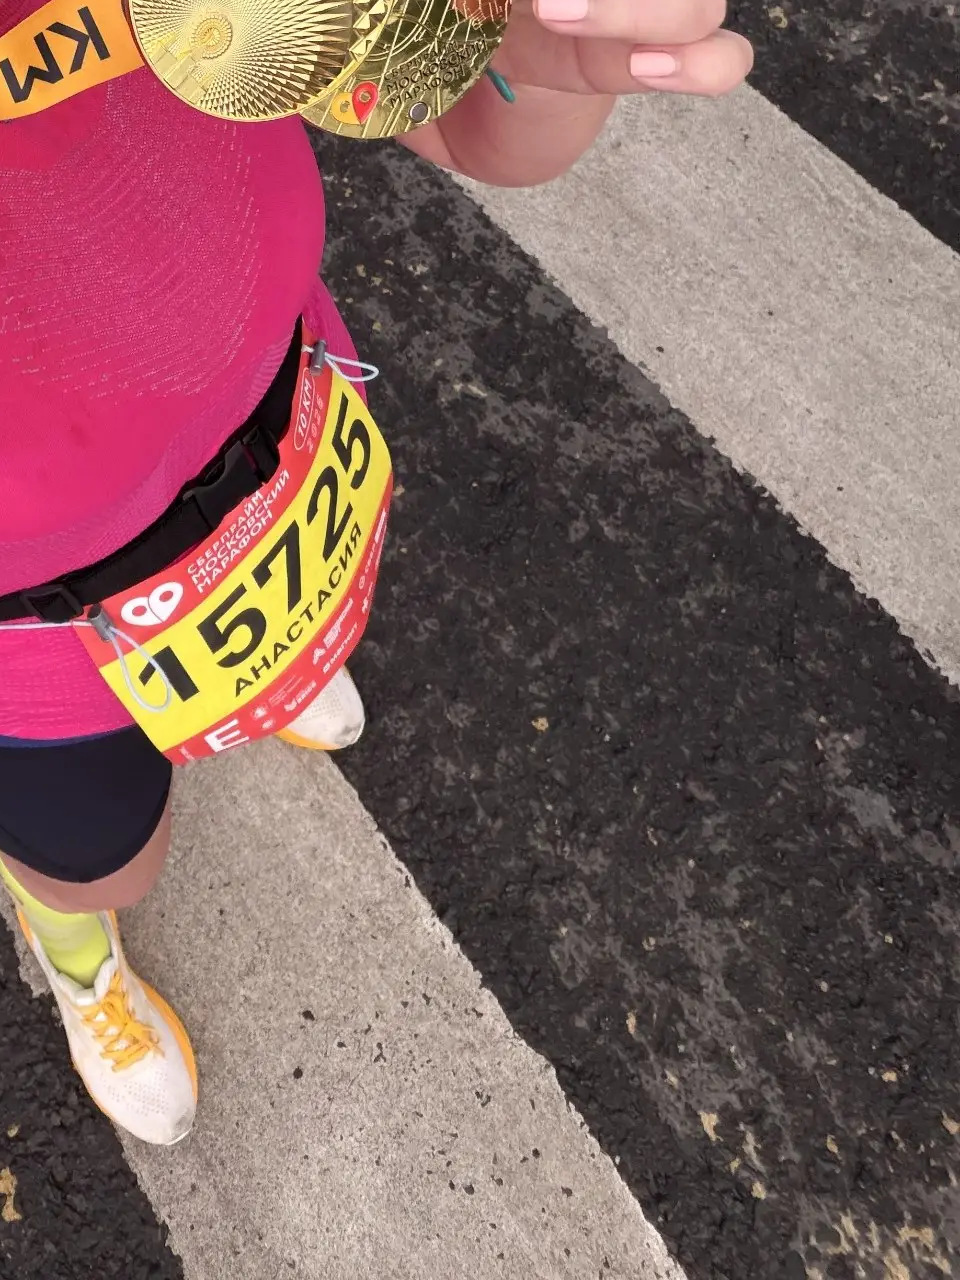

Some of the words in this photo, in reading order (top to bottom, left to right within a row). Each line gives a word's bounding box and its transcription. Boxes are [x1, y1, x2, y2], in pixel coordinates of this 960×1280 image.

[390, 64, 465, 108] МАРАФОН
[297, 416, 308, 438] 10
[138, 393, 372, 703] 15725
[187, 490, 264, 574] СБЕРПРАЙМ
[192, 469, 291, 585] МОСКОВСКИЙ
[198, 509, 273, 594] МАРАФОН
[234, 527, 364, 697] АНАСТАСИЯ
